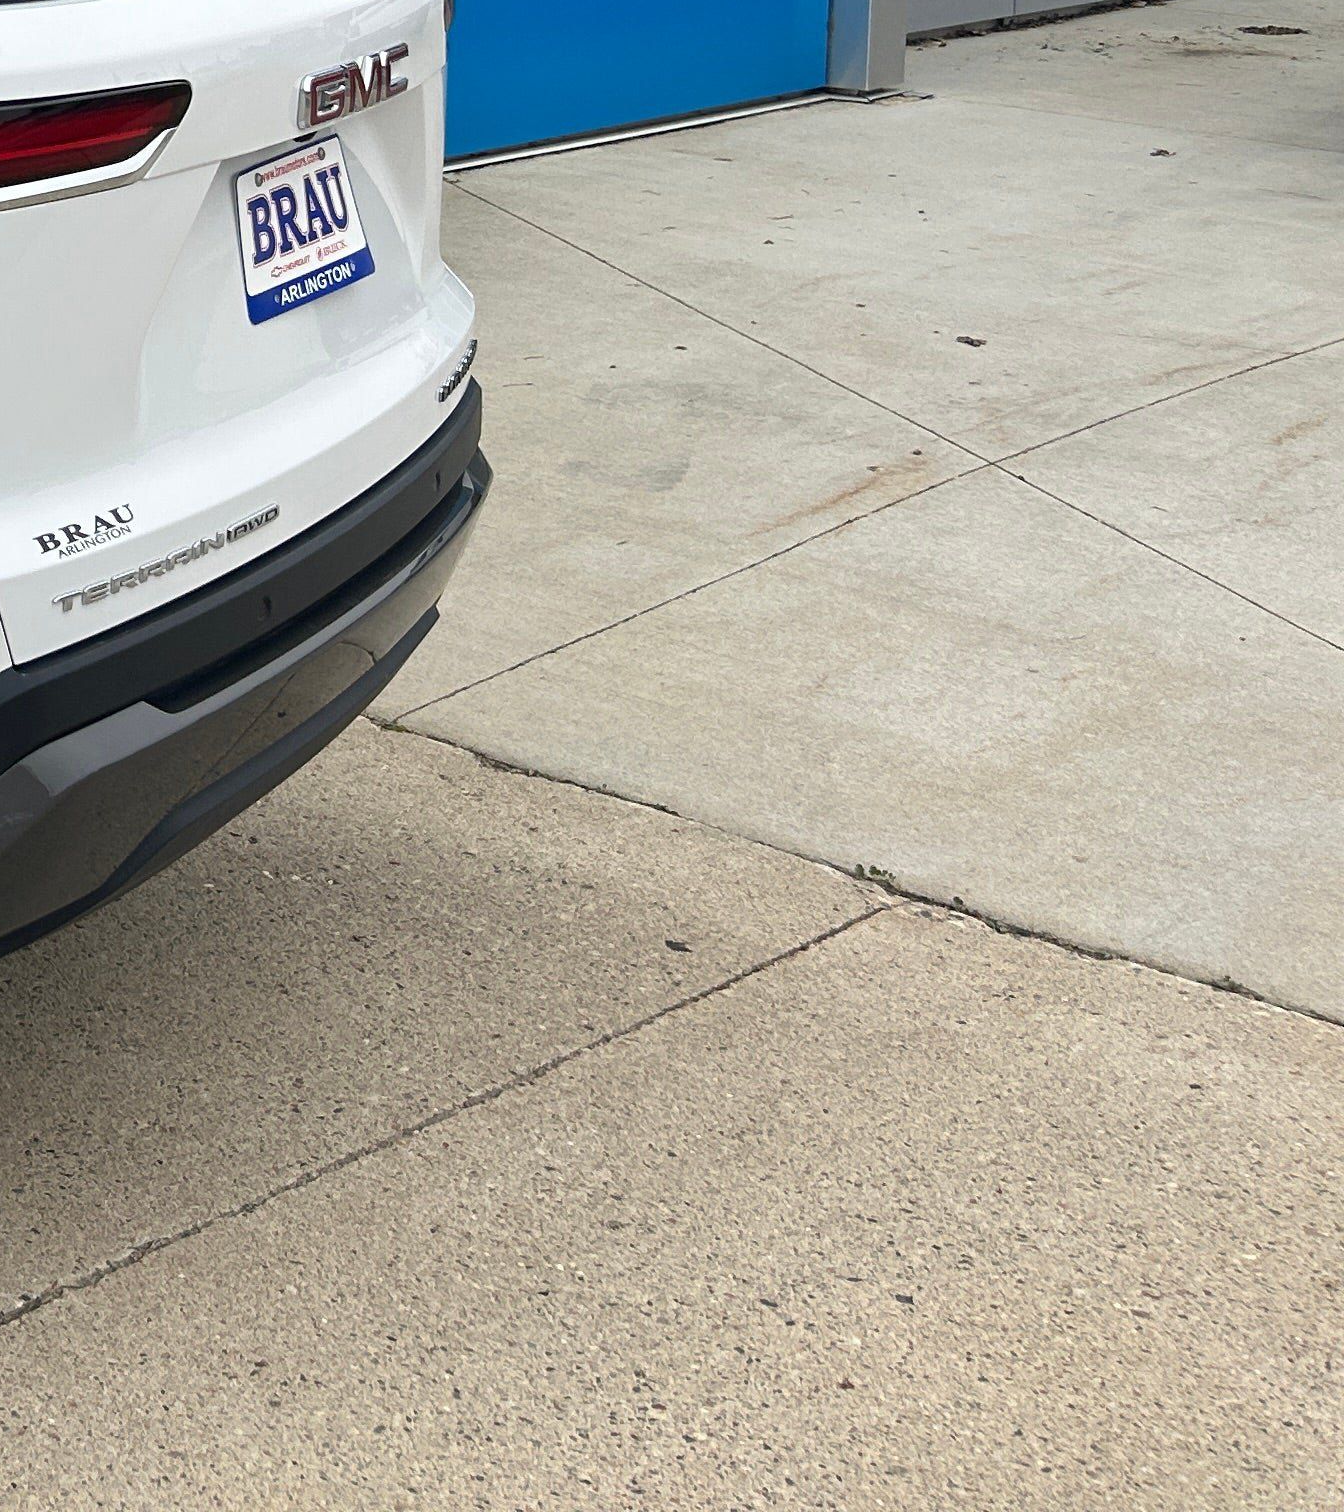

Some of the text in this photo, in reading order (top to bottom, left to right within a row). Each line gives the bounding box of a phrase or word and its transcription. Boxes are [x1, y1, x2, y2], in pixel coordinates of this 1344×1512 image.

[297, 42, 410, 130] GMC
[246, 162, 350, 269] BRAU
[280, 262, 352, 306] ARLINGTON
[32, 503, 135, 555] BRAU
[51, 504, 280, 614] TERRAIN AWD
[58, 524, 133, 560] ARLINGTON
